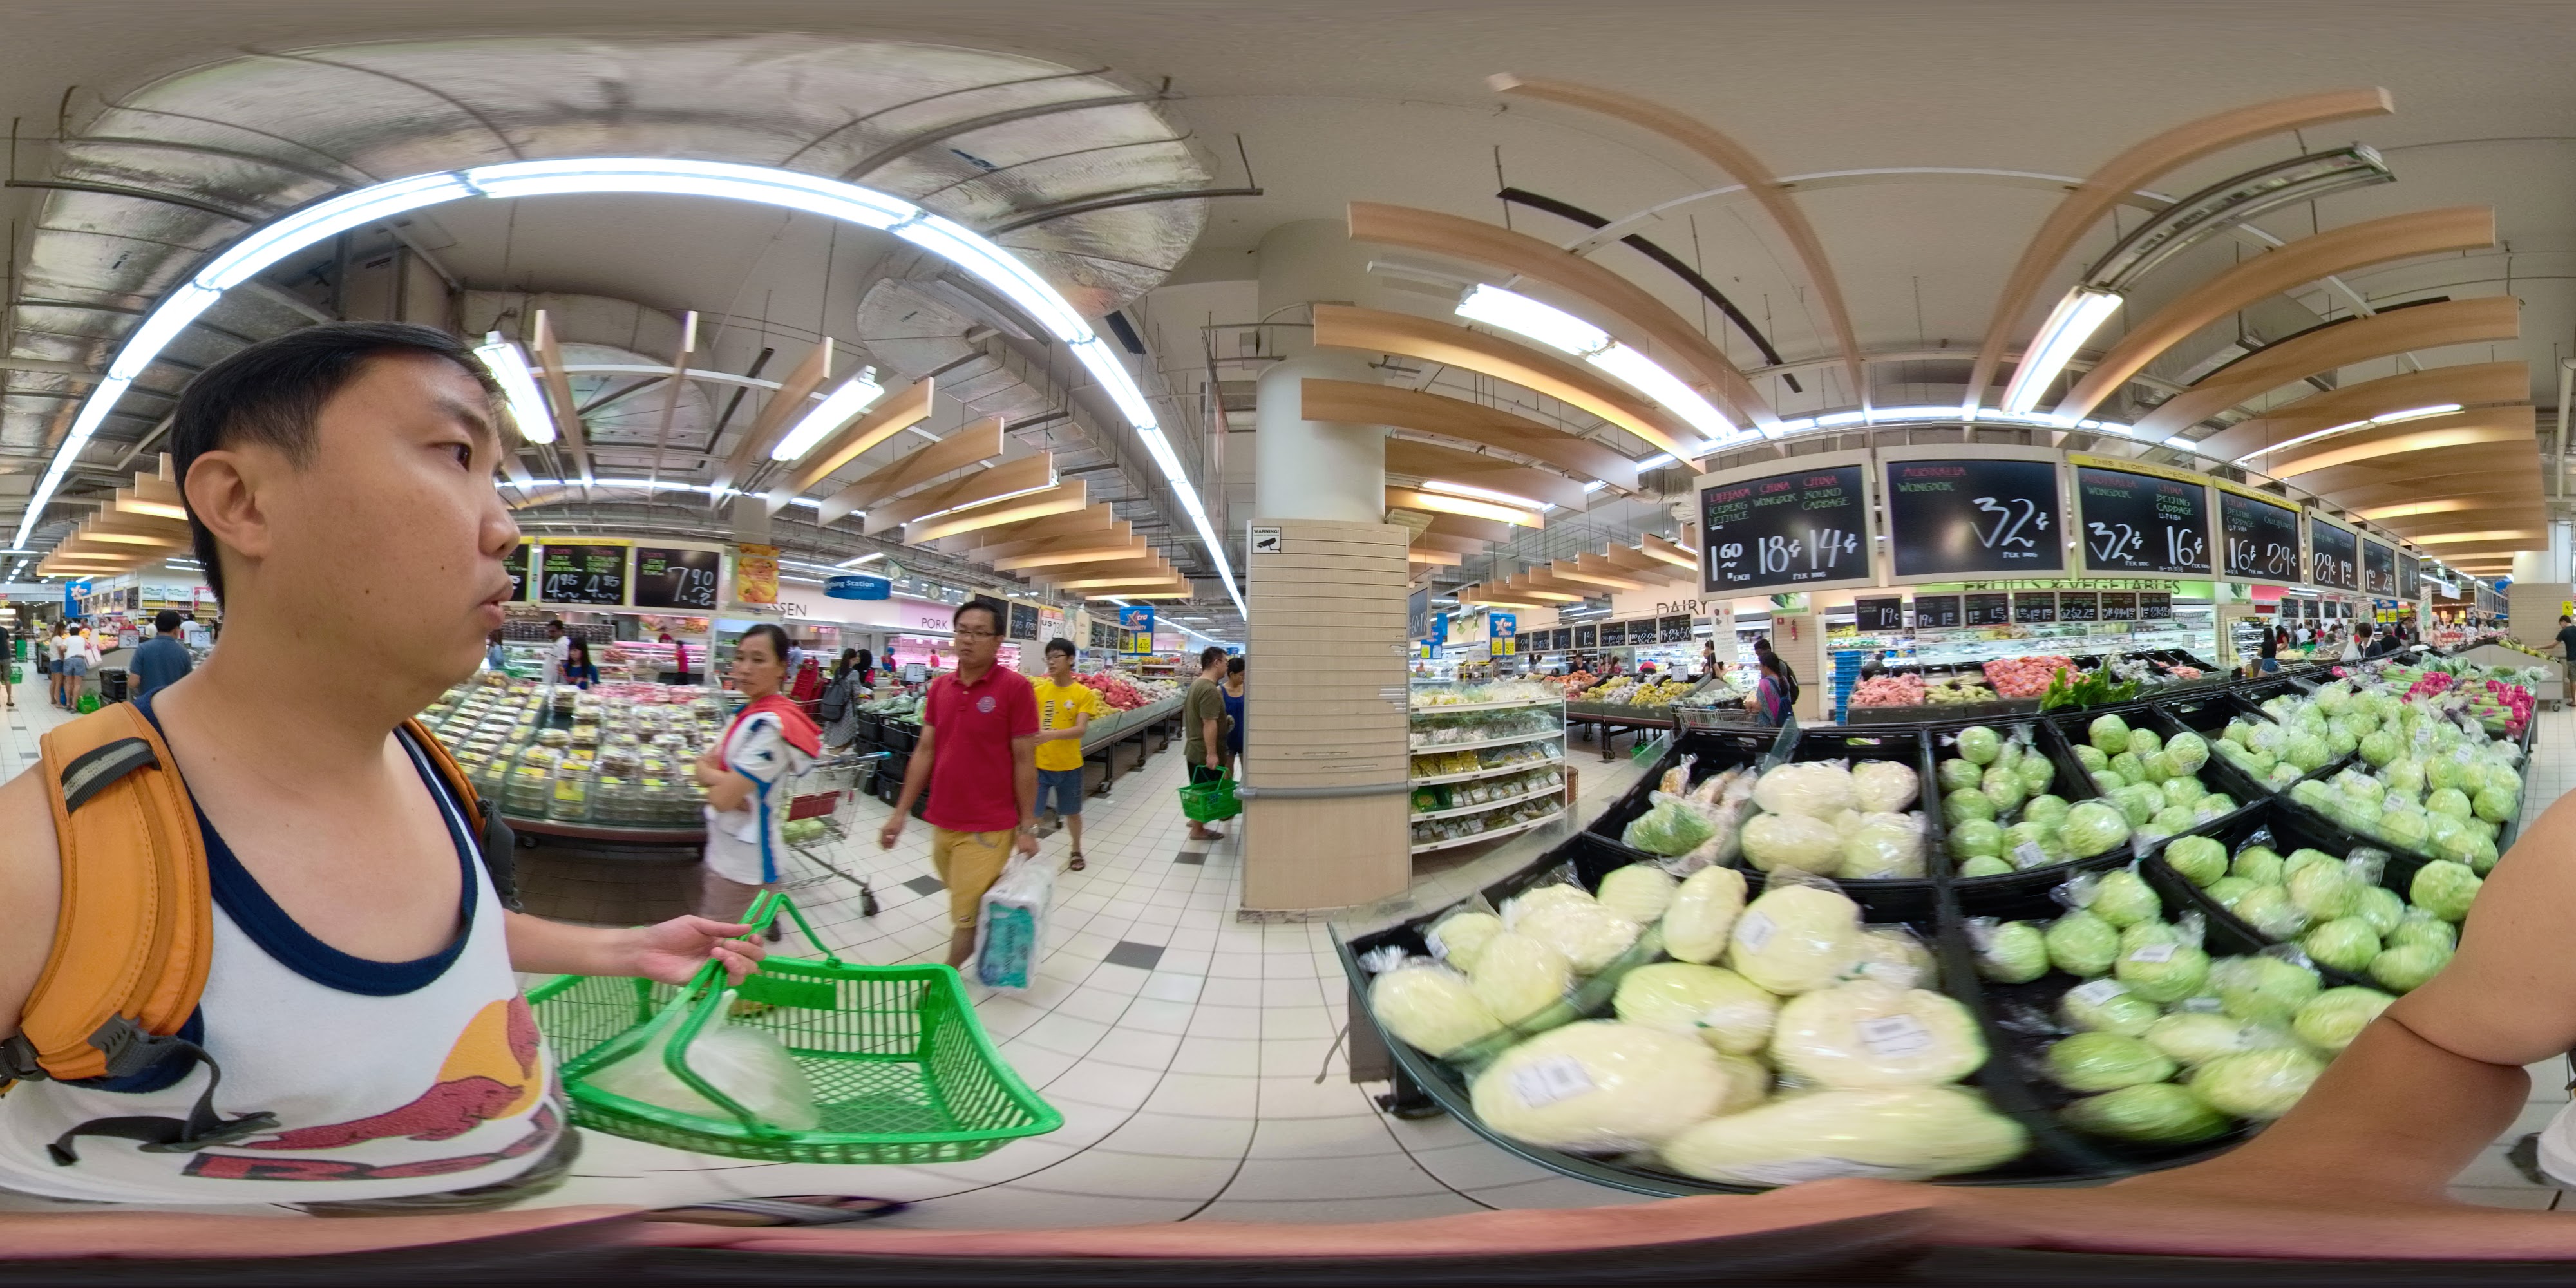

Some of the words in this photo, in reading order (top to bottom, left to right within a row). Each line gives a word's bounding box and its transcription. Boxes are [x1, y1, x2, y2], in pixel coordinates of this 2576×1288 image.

[2119, 462, 2157, 473] STORE'S
[2162, 469, 2195, 481] SPECIAL
[1803, 475, 1838, 487] CHINA
[1759, 482, 1790, 494] CHINA
[1804, 488, 1841, 499] ROUND
[2158, 484, 2183, 495] CHINA
[2156, 493, 2190, 506] BEIJING
[2226, 498, 2248, 509] CHINA
[2247, 490, 2271, 500] STORE'S
[2273, 498, 2294, 508] SPECIAL
[1656, 600, 1708, 615] DAIRY
[922, 618, 948, 630] PORK
